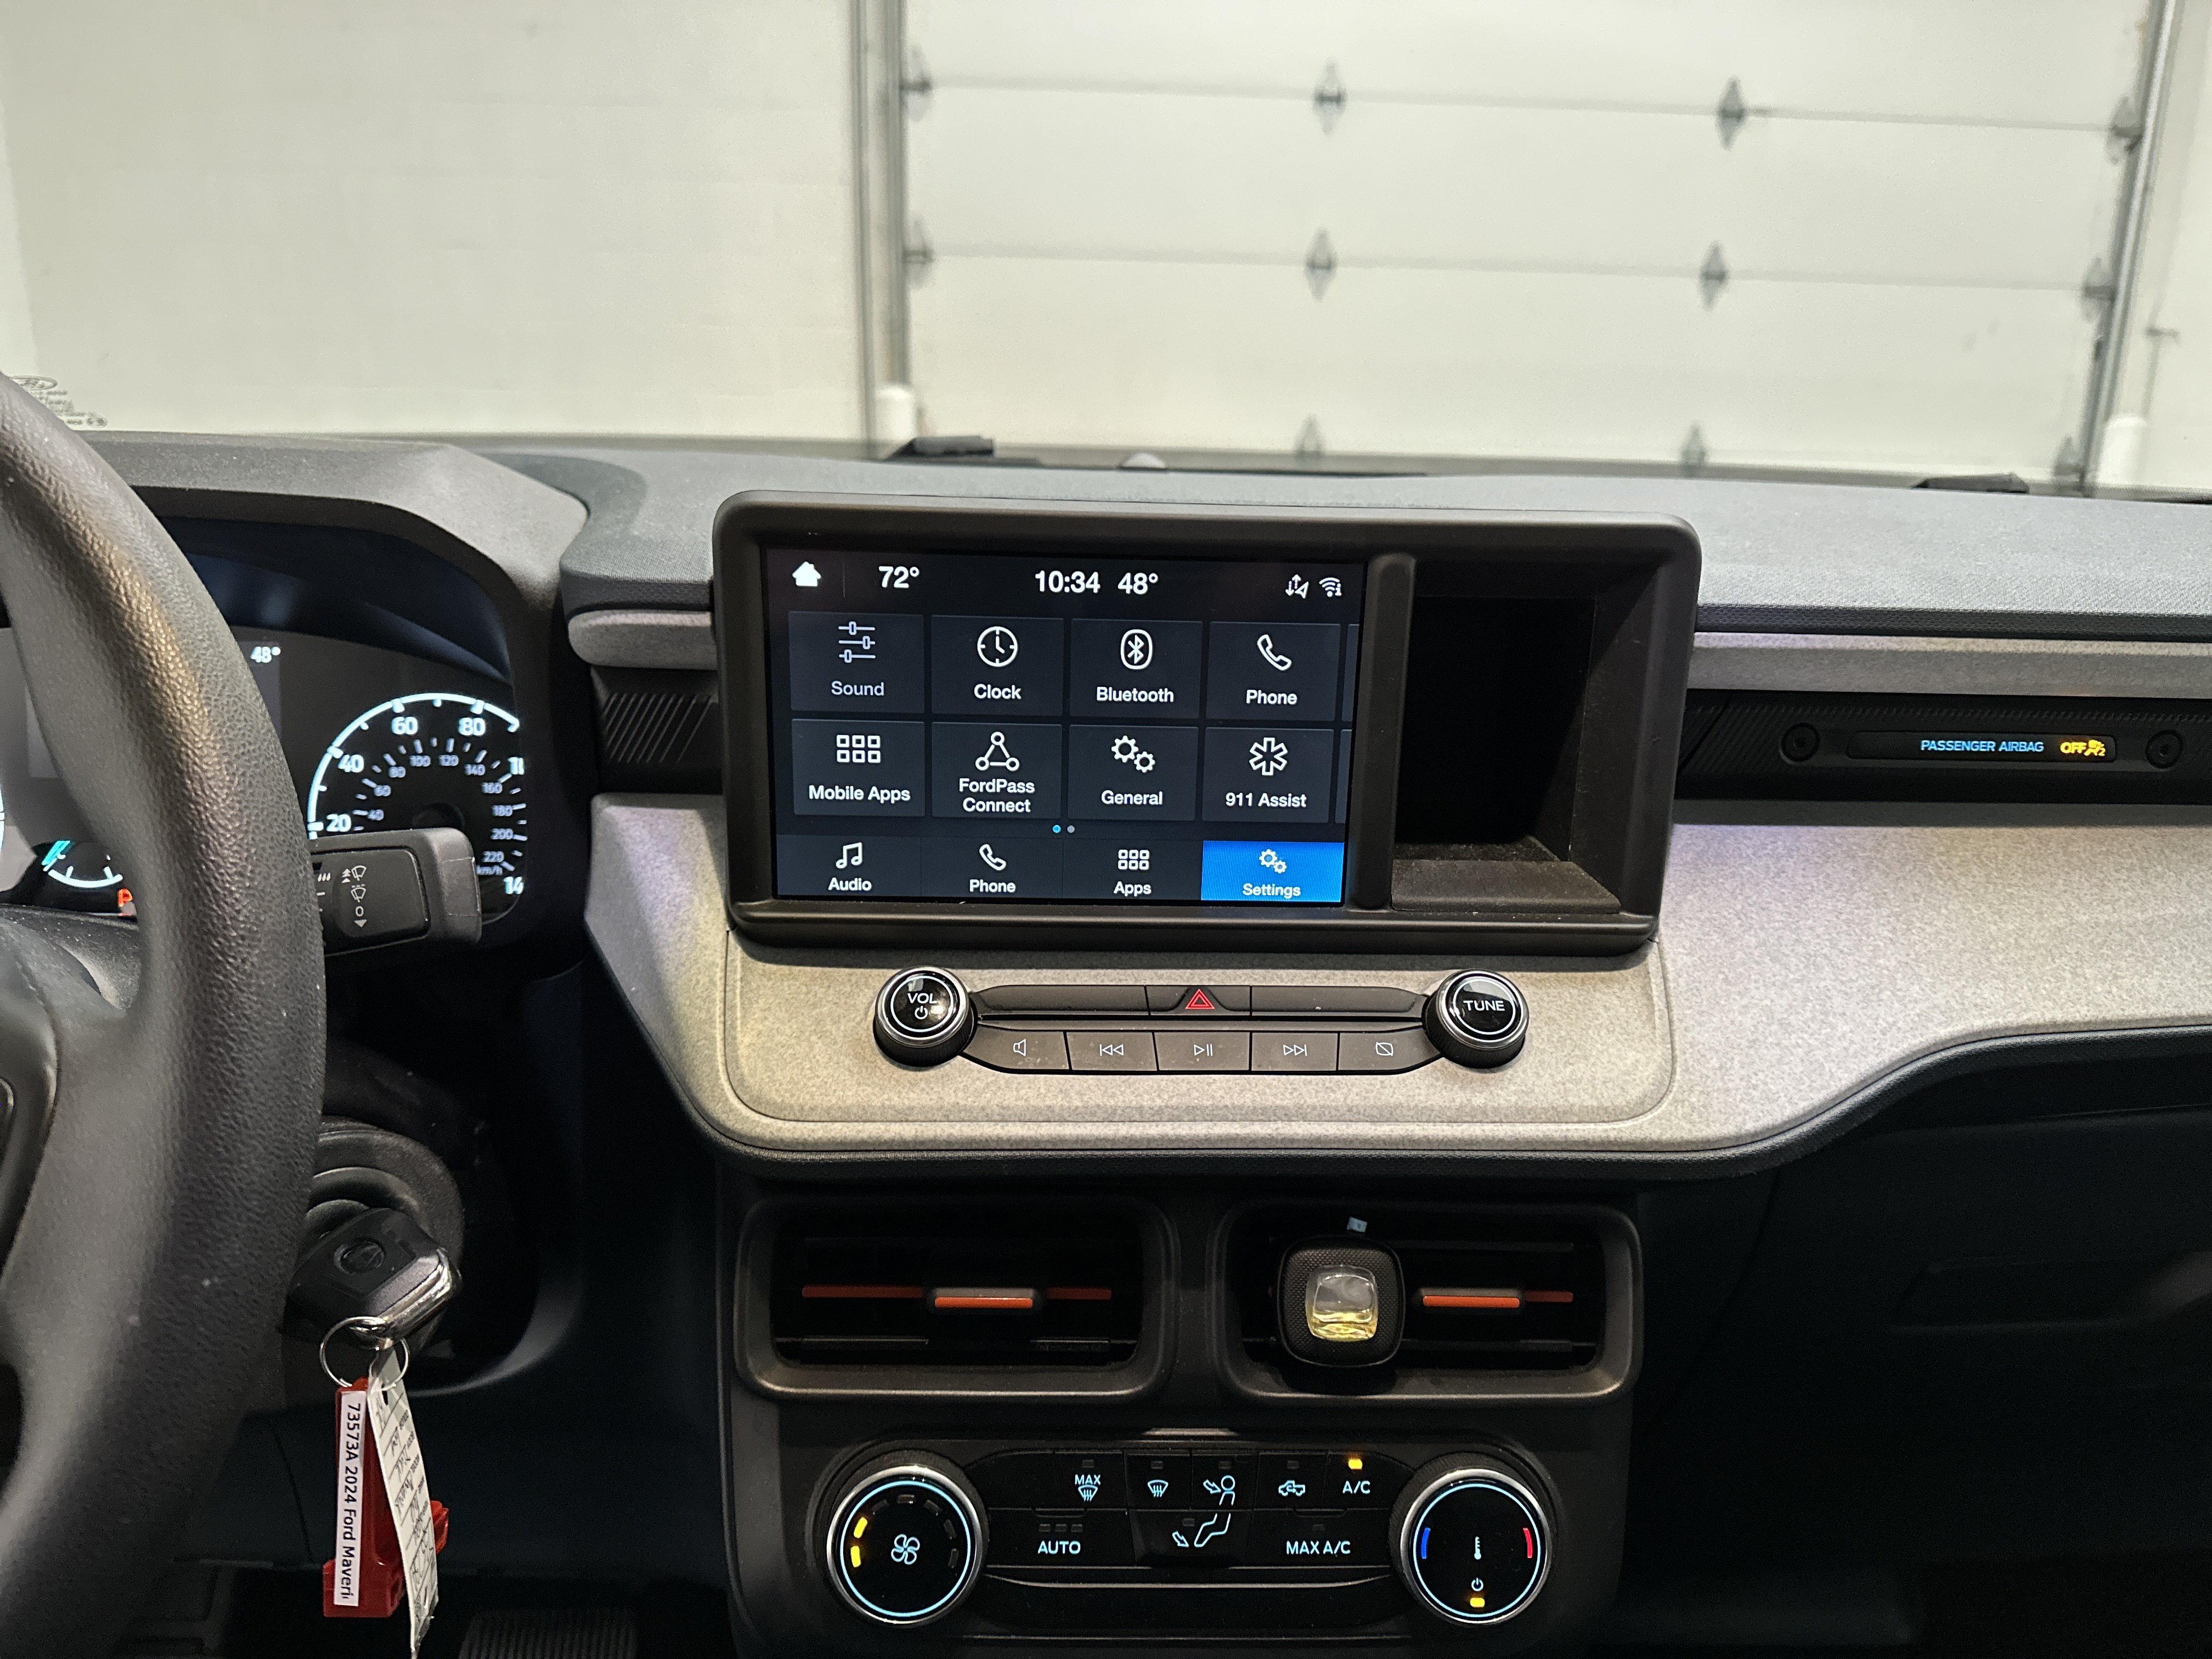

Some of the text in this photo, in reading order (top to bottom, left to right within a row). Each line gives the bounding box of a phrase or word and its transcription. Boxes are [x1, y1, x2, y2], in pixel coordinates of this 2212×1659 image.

[879, 566, 919, 588] 72°
[1035, 571, 1158, 594] 10:34 48°
[832, 681, 884, 696] Sound
[974, 684, 1021, 699] Clock
[1097, 687, 1173, 702] Bluetooth
[1246, 690, 1297, 704] Phone
[392, 716, 418, 735] 60
[459, 718, 486, 736] 80
[1921, 740, 2086, 753] PASSENGER AIRBAG OFF
[338, 754, 364, 772] 40
[410, 755, 430, 766] 100
[439, 755, 459, 766] 120
[389, 766, 405, 778] 80
[465, 764, 485, 775] 140
[374, 785, 391, 796] 60
[482, 782, 503, 794] 160
[959, 778, 1035, 793] FordPass
[809, 785, 910, 803] Mobile Apps
[1102, 790, 1163, 805] General
[1226, 793, 1306, 807] 911 Assist
[493, 805, 512, 816] 180
[963, 798, 1030, 812] Connect
[368, 810, 383, 820] 40
[326, 814, 351, 832] 20
[492, 828, 513, 839] 200
[483, 851, 505, 862] 220
[828, 878, 872, 891] Audio
[970, 879, 1015, 893] Phone
[1114, 881, 1151, 896] Apps
[1243, 883, 1301, 899] Settings
[907, 993, 937, 1003] VOL
[1463, 1000, 1505, 1011] TUNE
[1075, 1475, 1101, 1485] MAX
[1342, 1481, 1370, 1494] A/C
[341, 1403, 360, 1599] 73573A 2024 Ford Maveri
[1038, 1541, 1080, 1554] AUTO
[1286, 1541, 1350, 1554] MAX A/C
